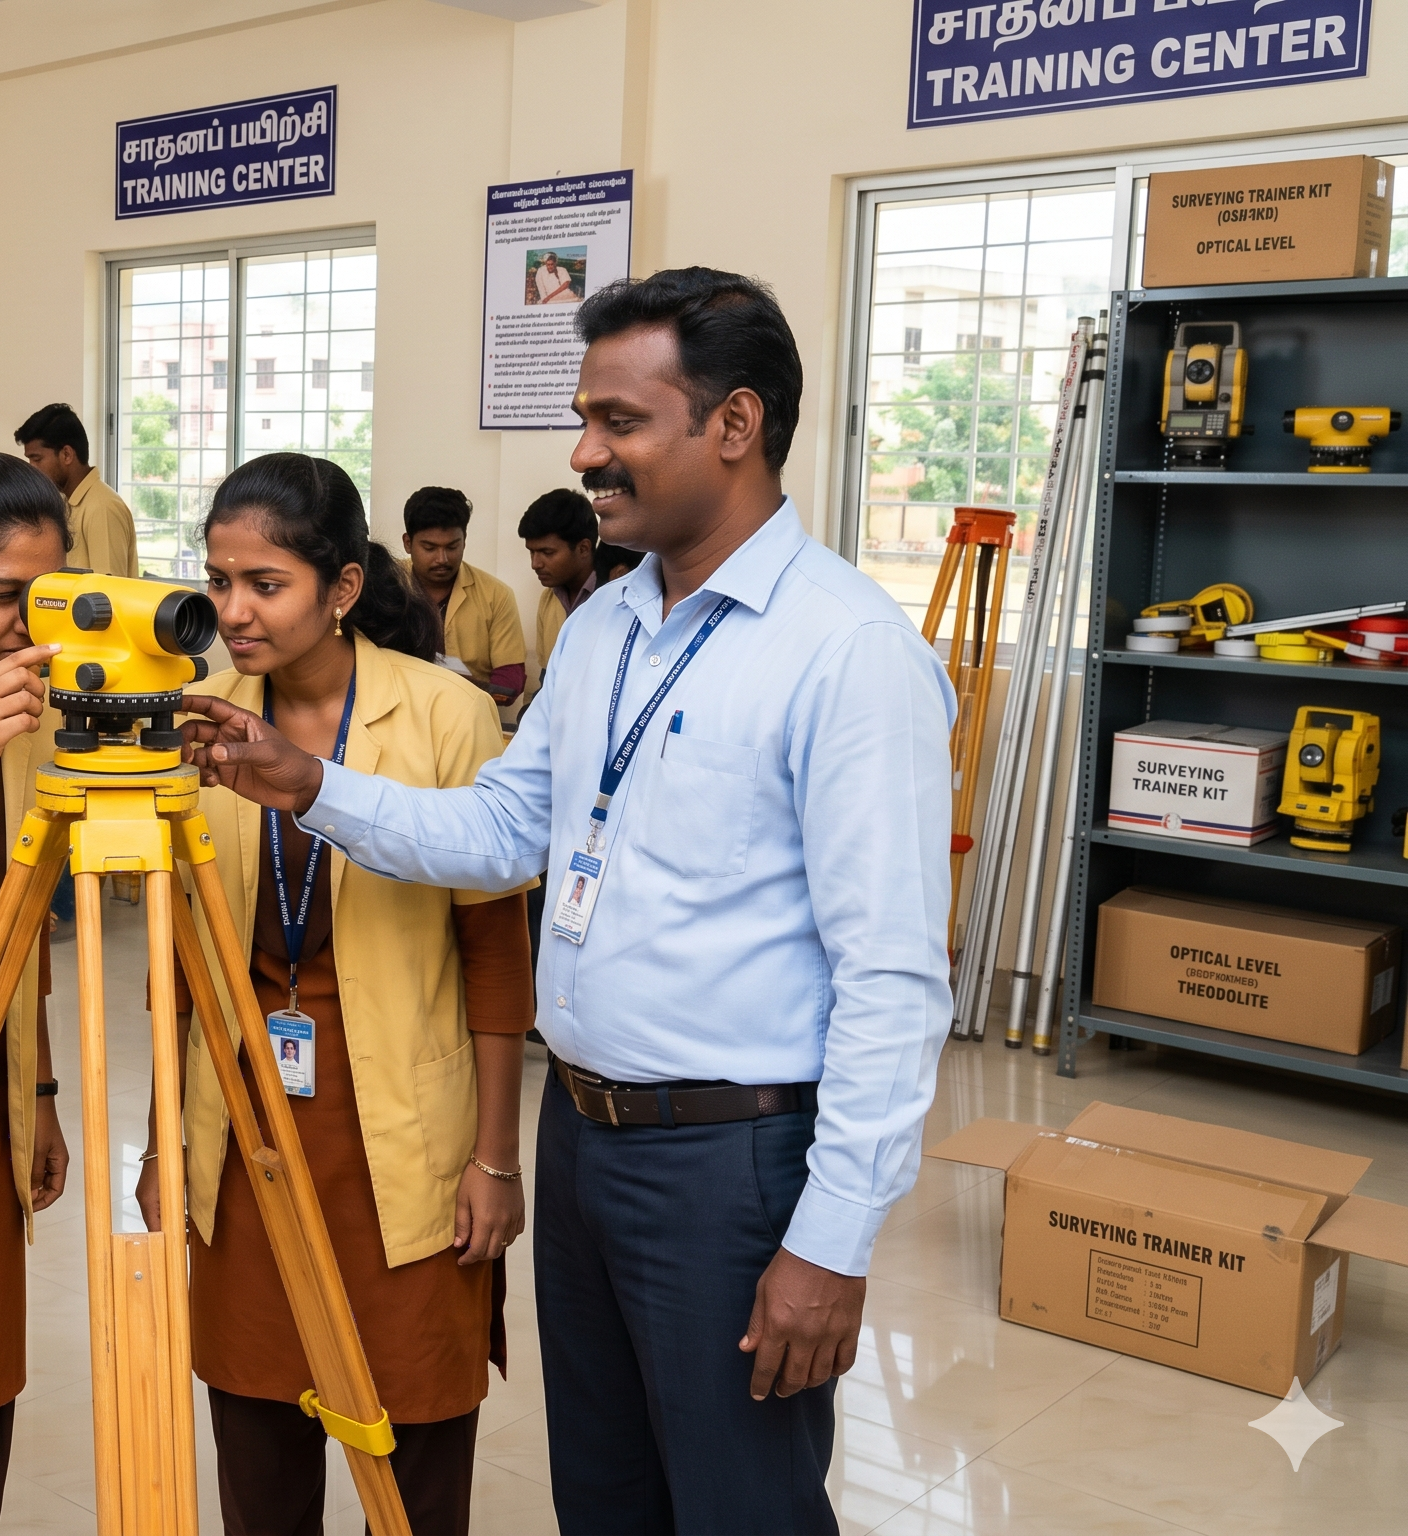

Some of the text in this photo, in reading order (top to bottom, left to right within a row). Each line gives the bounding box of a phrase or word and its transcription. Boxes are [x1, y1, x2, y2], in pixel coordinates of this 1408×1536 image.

[926, 14, 1347, 107] TRAINING CENTER
[122, 100, 327, 171] சாதனப் பயிற்சி
[123, 154, 325, 206] TRAINING CENTER
[1172, 183, 1332, 209] SURVEYING TRAINER KIT
[1196, 235, 1296, 255] OPTICAL LEVEL
[1137, 760, 1225, 783] SURVEYING
[1132, 777, 1229, 801] TRAINER KIT
[1170, 945, 1282, 977] OPTICAL LEVEL
[1177, 980, 1269, 1010] THEODOLITE
[1048, 1210, 1246, 1273] SURVEYING TRAINER KIT
